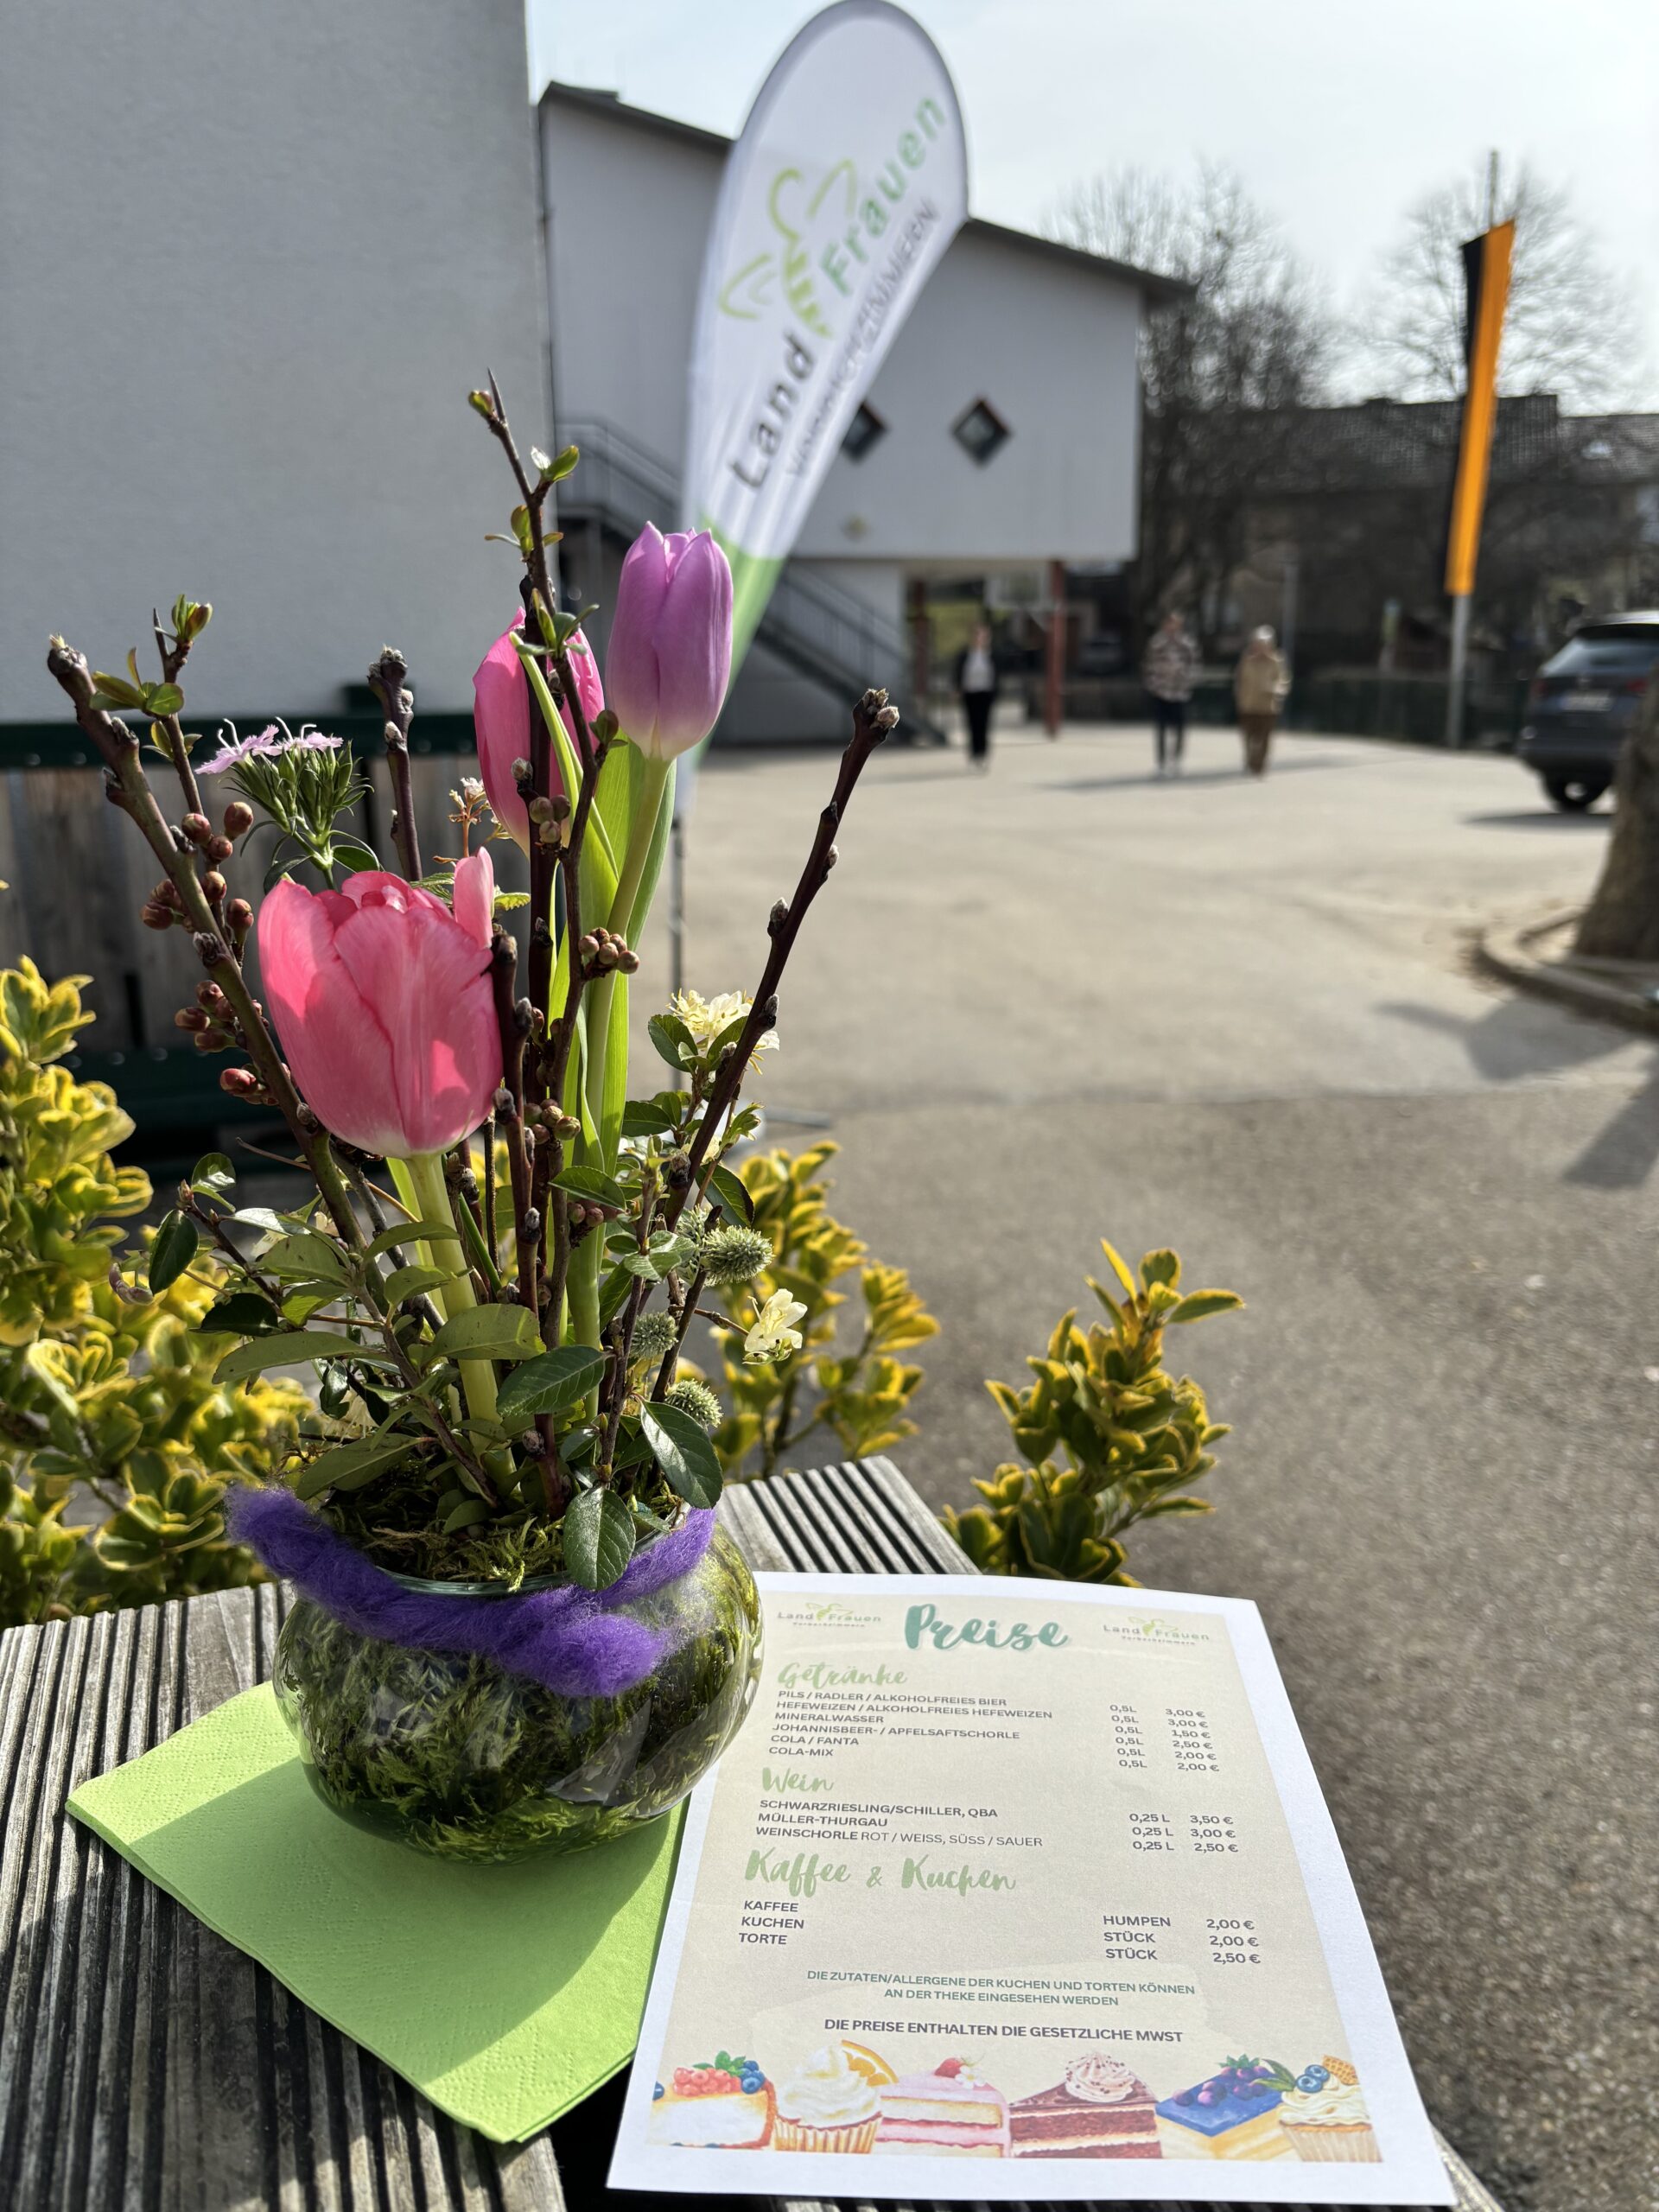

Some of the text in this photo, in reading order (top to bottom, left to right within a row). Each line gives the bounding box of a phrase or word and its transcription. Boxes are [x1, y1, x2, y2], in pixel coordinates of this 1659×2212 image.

[729, 96, 947, 490] Land Frauen
[778, 1612, 881, 1623] Land Frauen
[905, 1604, 1068, 1650] Preise
[1103, 1624, 1210, 1640] Land Frauen
[778, 1662, 907, 1689] Getränke
[779, 1690, 805, 1699] PILS
[815, 1692, 863, 1700] RADLER
[874, 1694, 976, 1705] ALKOHOLFREIES
[776, 1701, 855, 1711] HEFEWEIZEN
[866, 1705, 969, 1714] ALKOHOLFREIES
[972, 1709, 1052, 1719] HEFEWEIZEN
[1109, 1704, 1137, 1713] 0,5L
[1165, 1708, 1193, 1717] 3,00
[774, 1713, 884, 1723] MINERALWASSER
[1111, 1714, 1139, 1723] 0,5L
[1168, 1719, 1196, 1727] 3,00
[772, 1723, 878, 1733] JOHANNISBEER-
[888, 1728, 1020, 1739] APFELSAFTSCHORLE
[1115, 1726, 1142, 1734] 0,5L
[1172, 1730, 1198, 1738] 1,50
[771, 1735, 805, 1744] COLA
[817, 1737, 859, 1745] FANTA
[1115, 1737, 1144, 1745] 0,5L
[1173, 1740, 1199, 1749] 2,50
[769, 1746, 834, 1757] COLA-MIX
[1116, 1747, 1146, 1757] 0,5L
[1175, 1751, 1205, 1760] 2,00
[1119, 1759, 1147, 1768] 0,5L
[1177, 1763, 1206, 1771] 2,00
[762, 1767, 835, 1793] Wein
[760, 1800, 999, 1818] SCHWARZRIESLING/SCHILLER, QBA
[758, 1813, 888, 1827] MÜLLER-THURGAU
[1129, 1813, 1159, 1823] 0,25
[1190, 1815, 1234, 1825] 3,50 €
[756, 1827, 859, 1840] WEINSCHORLE
[861, 1832, 889, 1841] ROT
[900, 1834, 945, 1845] WEISS,
[949, 1834, 985, 1845] SÜSS
[996, 1837, 1043, 1847] SAUER
[1132, 1827, 1173, 1837] 0,25 L
[1191, 1828, 1222, 1839] 3,00
[1133, 1840, 1175, 1851] 0,25 L
[1194, 1843, 1238, 1853] 2,50 €
[745, 1847, 1016, 1897] Kaffee & Kuchen
[743, 1901, 798, 1912] KAFFEE
[741, 1916, 804, 1929] KUCHEN
[1103, 1915, 1171, 1927] HUMPEN
[1206, 1918, 1255, 1930] 2,00 €
[738, 1932, 788, 1944] TORTE
[1103, 1930, 1156, 1942] STÜCK
[1210, 1936, 1260, 1948] 2,00 €
[1105, 1948, 1158, 1960] STÜCK
[1213, 1953, 1262, 1965] 2,50 €
[807, 1970, 1195, 1994] DIE ZUTATEN/ALLERGENE DER KUCHEN UND TORTEN KÖNNEN
[885, 1989, 1118, 2006] AN DER THEKE EINGESEHEN WERDEN
[824, 2018, 1183, 2043] DIE PREISE ENTHALTEN DIE GESETZLICHE MWST
